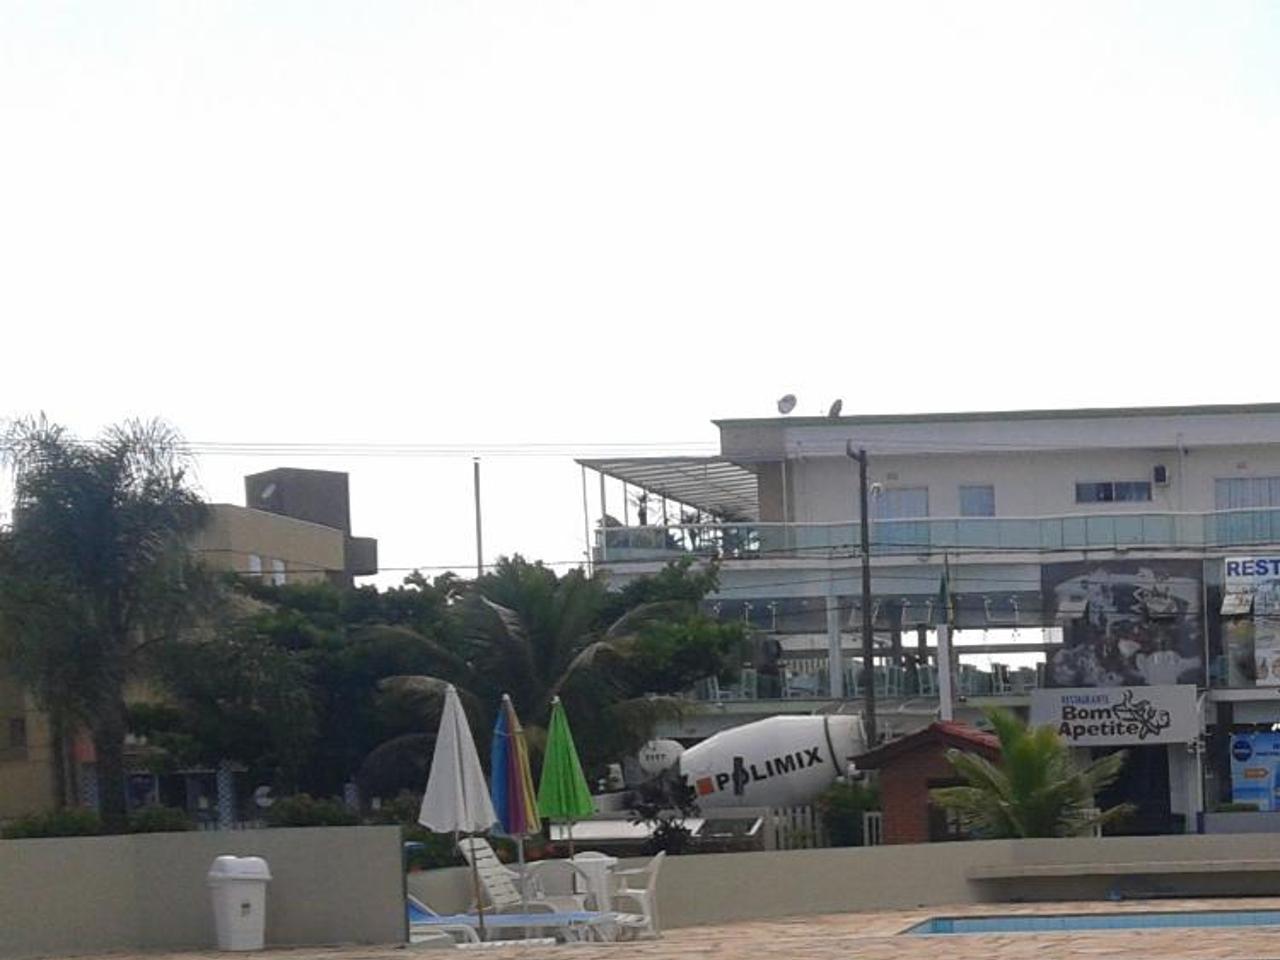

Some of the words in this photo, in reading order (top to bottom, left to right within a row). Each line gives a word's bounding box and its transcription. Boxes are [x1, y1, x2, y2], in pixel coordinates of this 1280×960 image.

[1062, 705, 1112, 720] Bom
[1059, 721, 1139, 741] Apetite
[715, 746, 823, 796] POLIMIX
